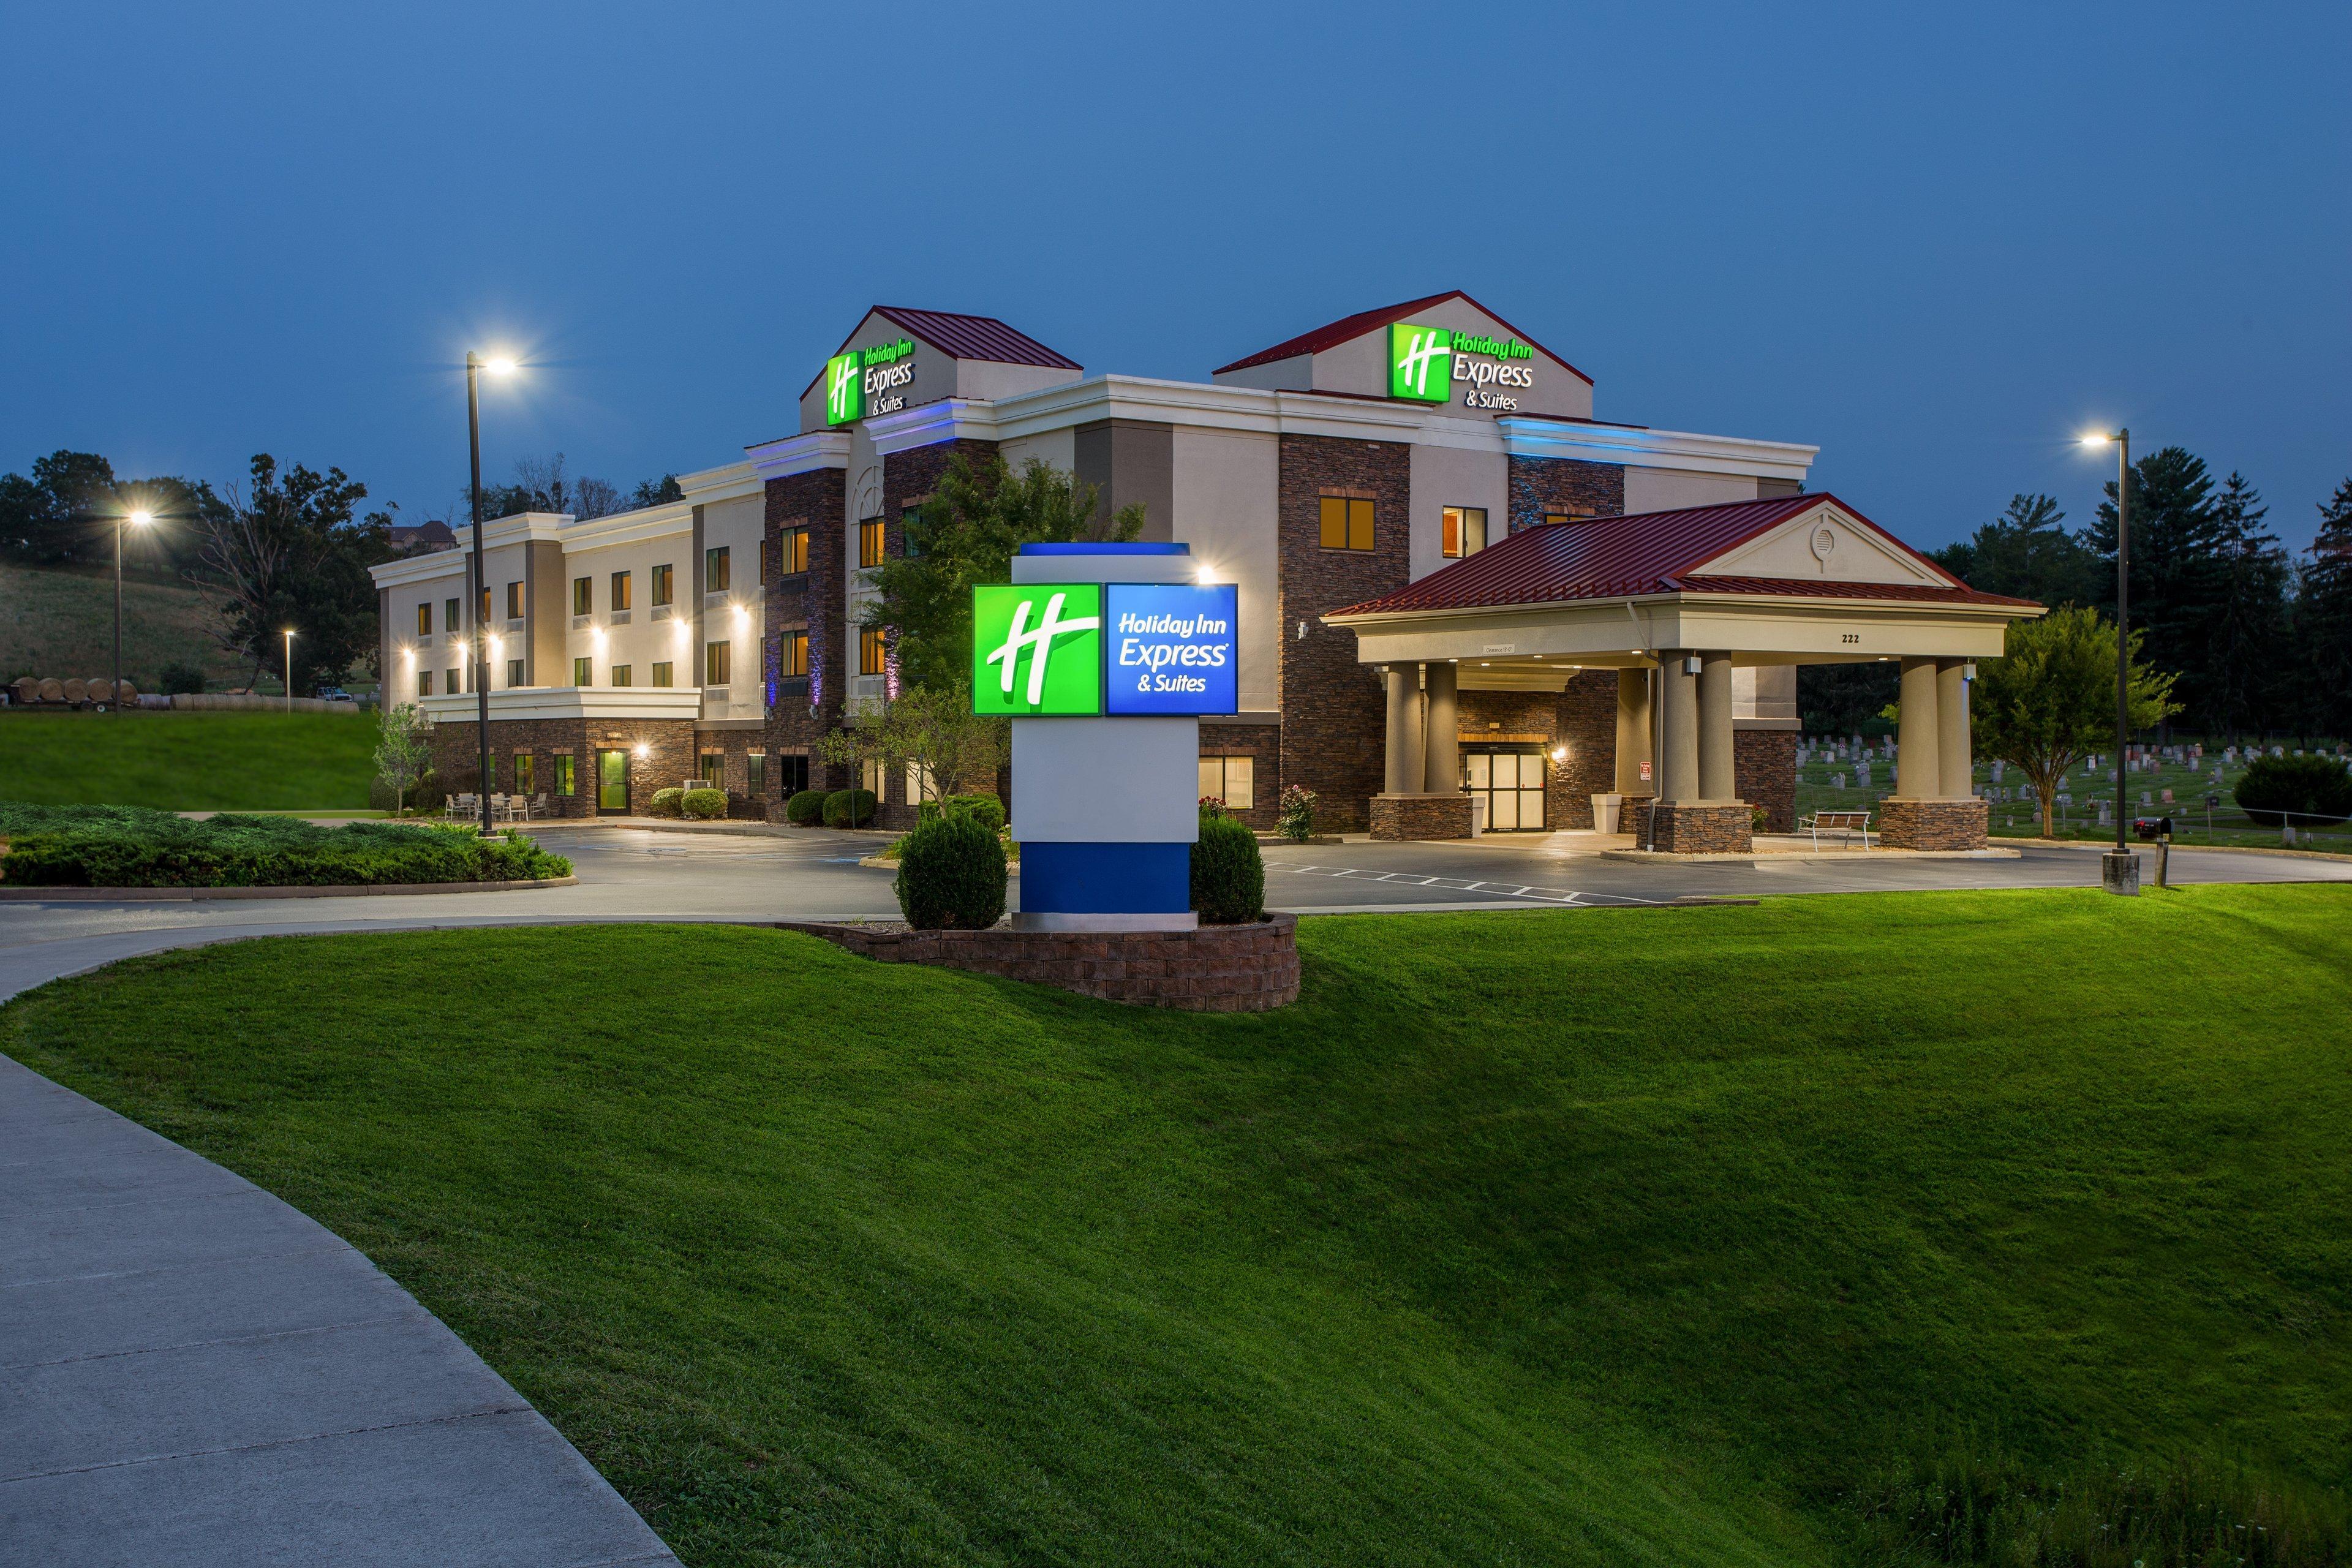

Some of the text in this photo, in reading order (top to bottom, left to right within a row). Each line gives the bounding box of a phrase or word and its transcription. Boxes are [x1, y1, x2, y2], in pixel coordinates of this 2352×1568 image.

[864, 338, 911, 366] Holiday Inn
[1452, 331, 1532, 360] Holiday Inn
[864, 363, 911, 397] Express
[1453, 353, 1532, 389] Express
[872, 396, 903, 416] & Suites
[1466, 390, 1517, 410] & Suites
[1118, 613, 1226, 638] Holiday Inn
[1842, 634, 1860, 643] 222
[1119, 638, 1227, 673] Express
[1137, 674, 1206, 692] & Suites
